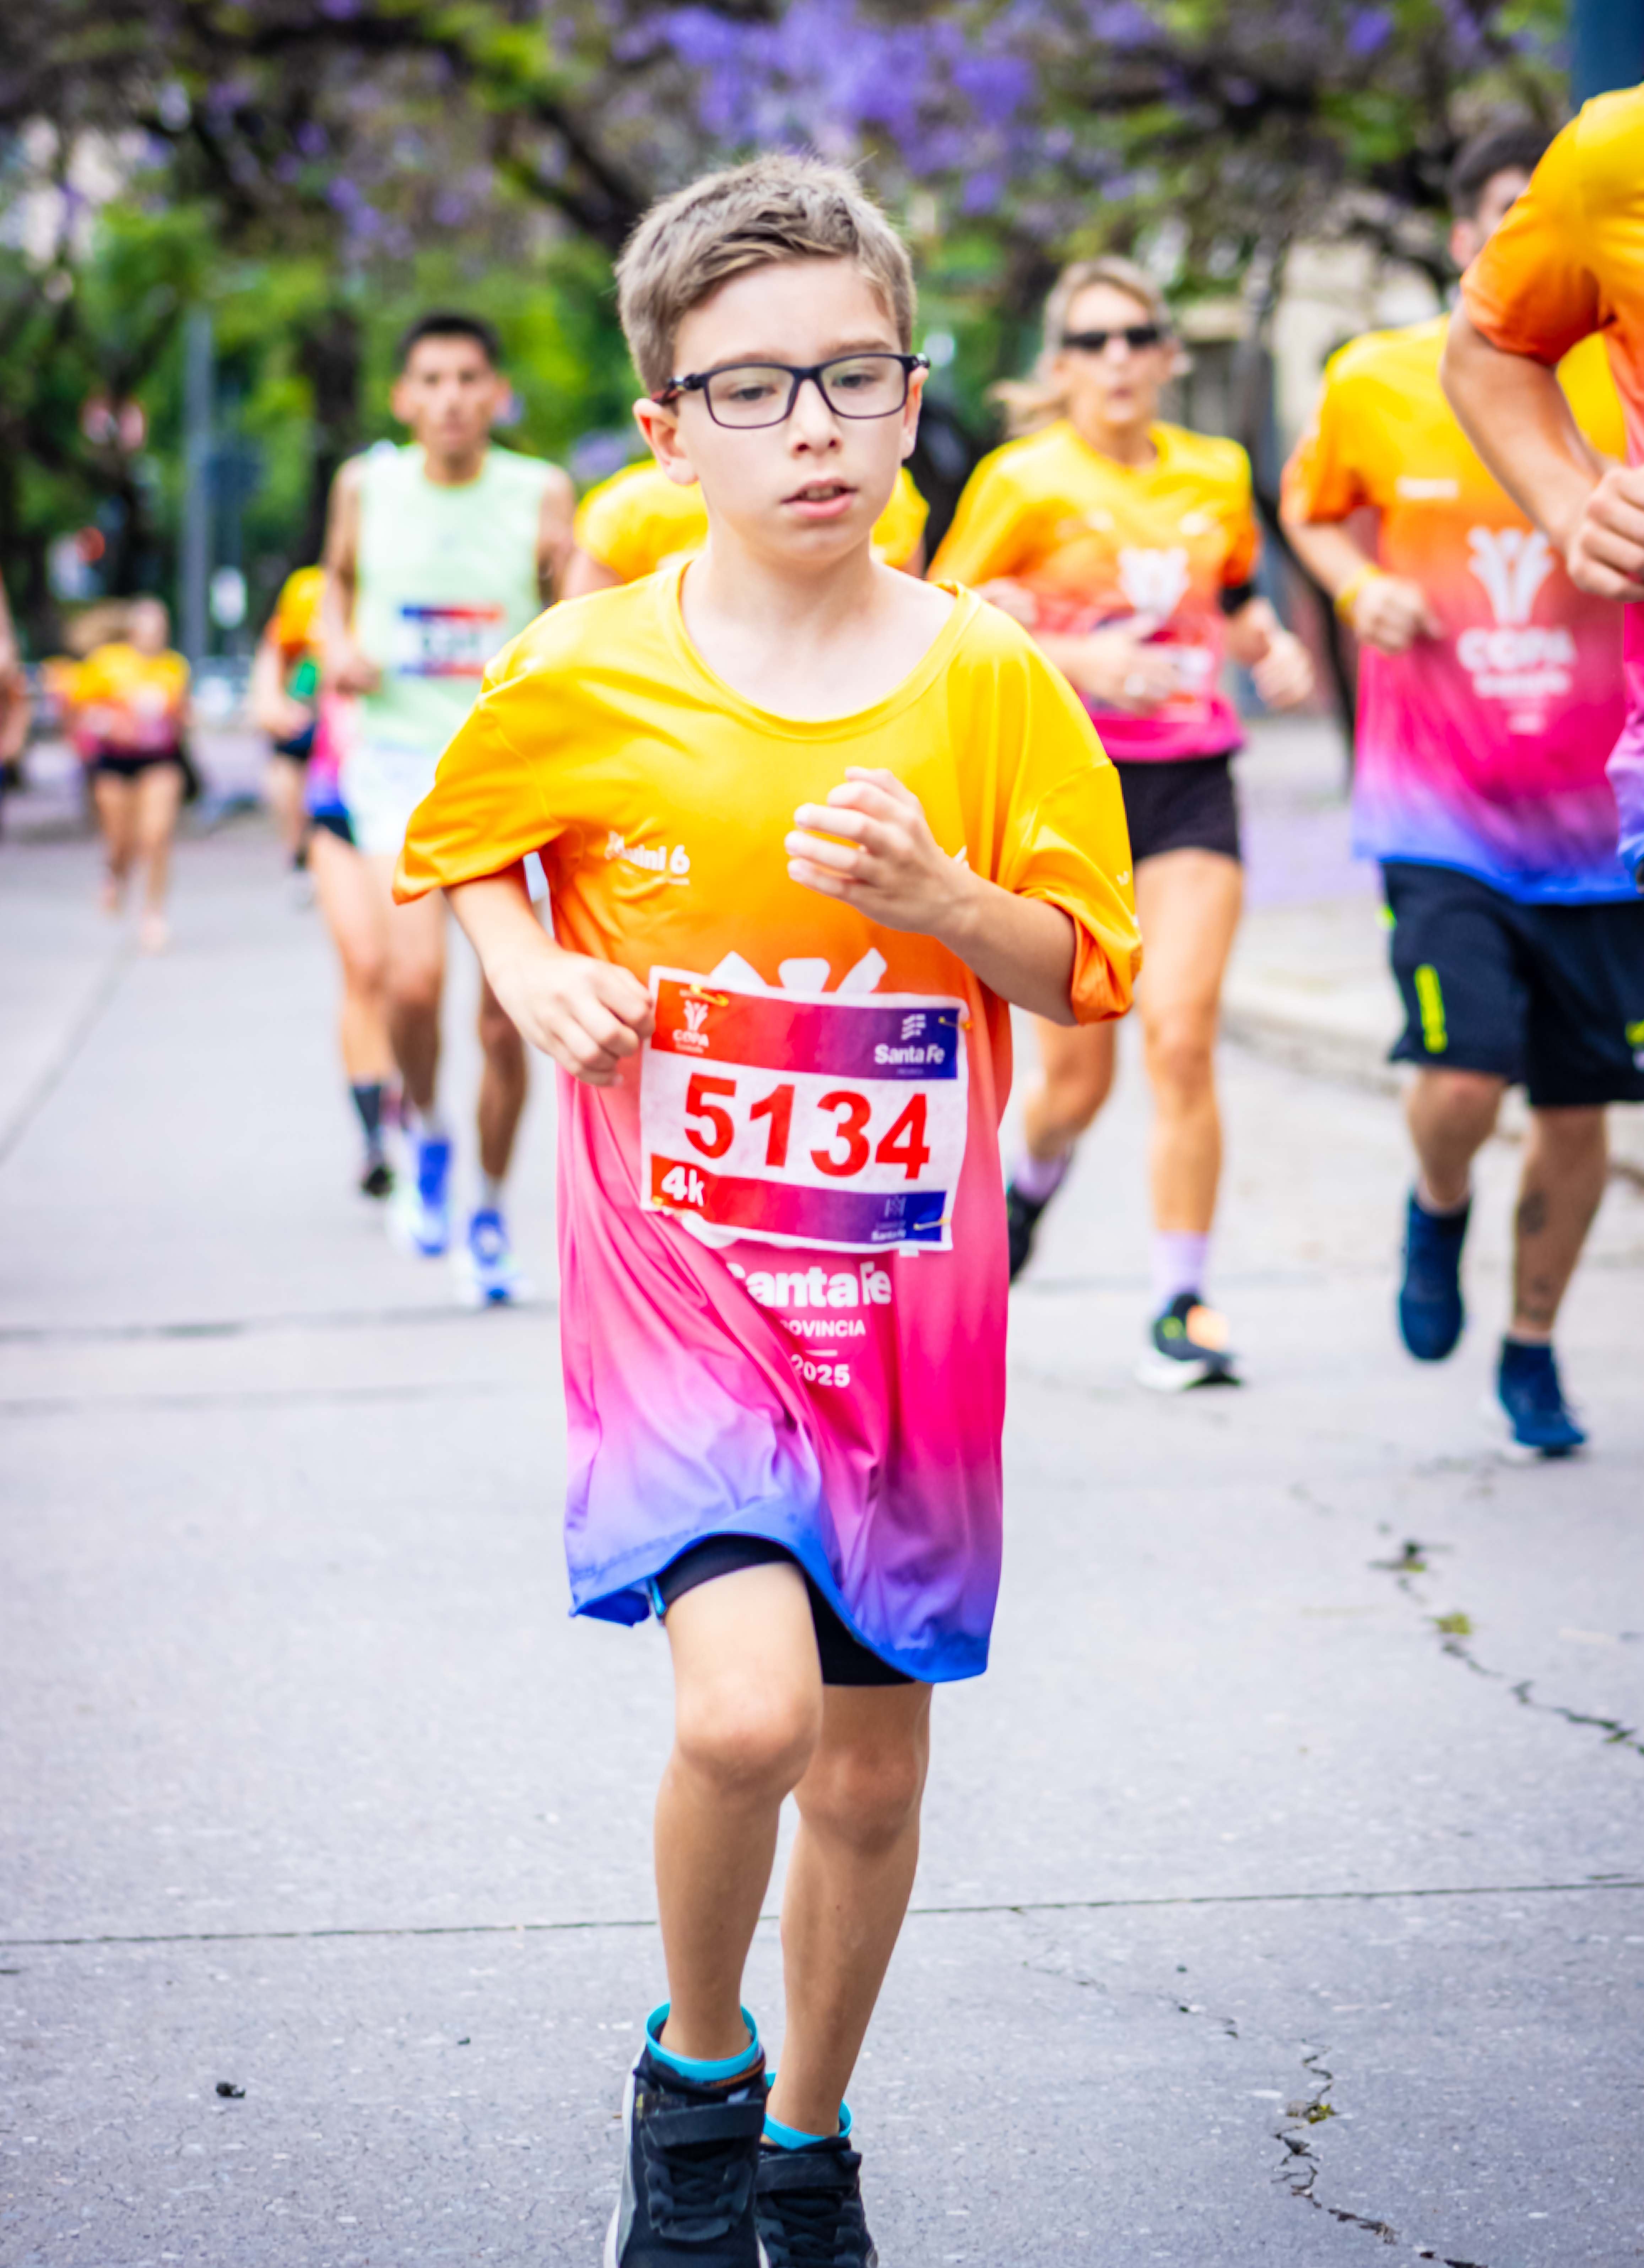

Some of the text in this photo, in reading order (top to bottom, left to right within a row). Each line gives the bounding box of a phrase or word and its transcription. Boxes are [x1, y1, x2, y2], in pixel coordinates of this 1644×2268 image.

[669, 844, 691, 875] 6
[874, 1043, 945, 1065] Santa Fe
[685, 1072, 930, 1180] 5134
[661, 1165, 705, 1208] 4k
[859, 1260, 892, 1305] Fe
[780, 1319, 866, 1338] OVINCIA
[790, 1353, 851, 1388] 2025
